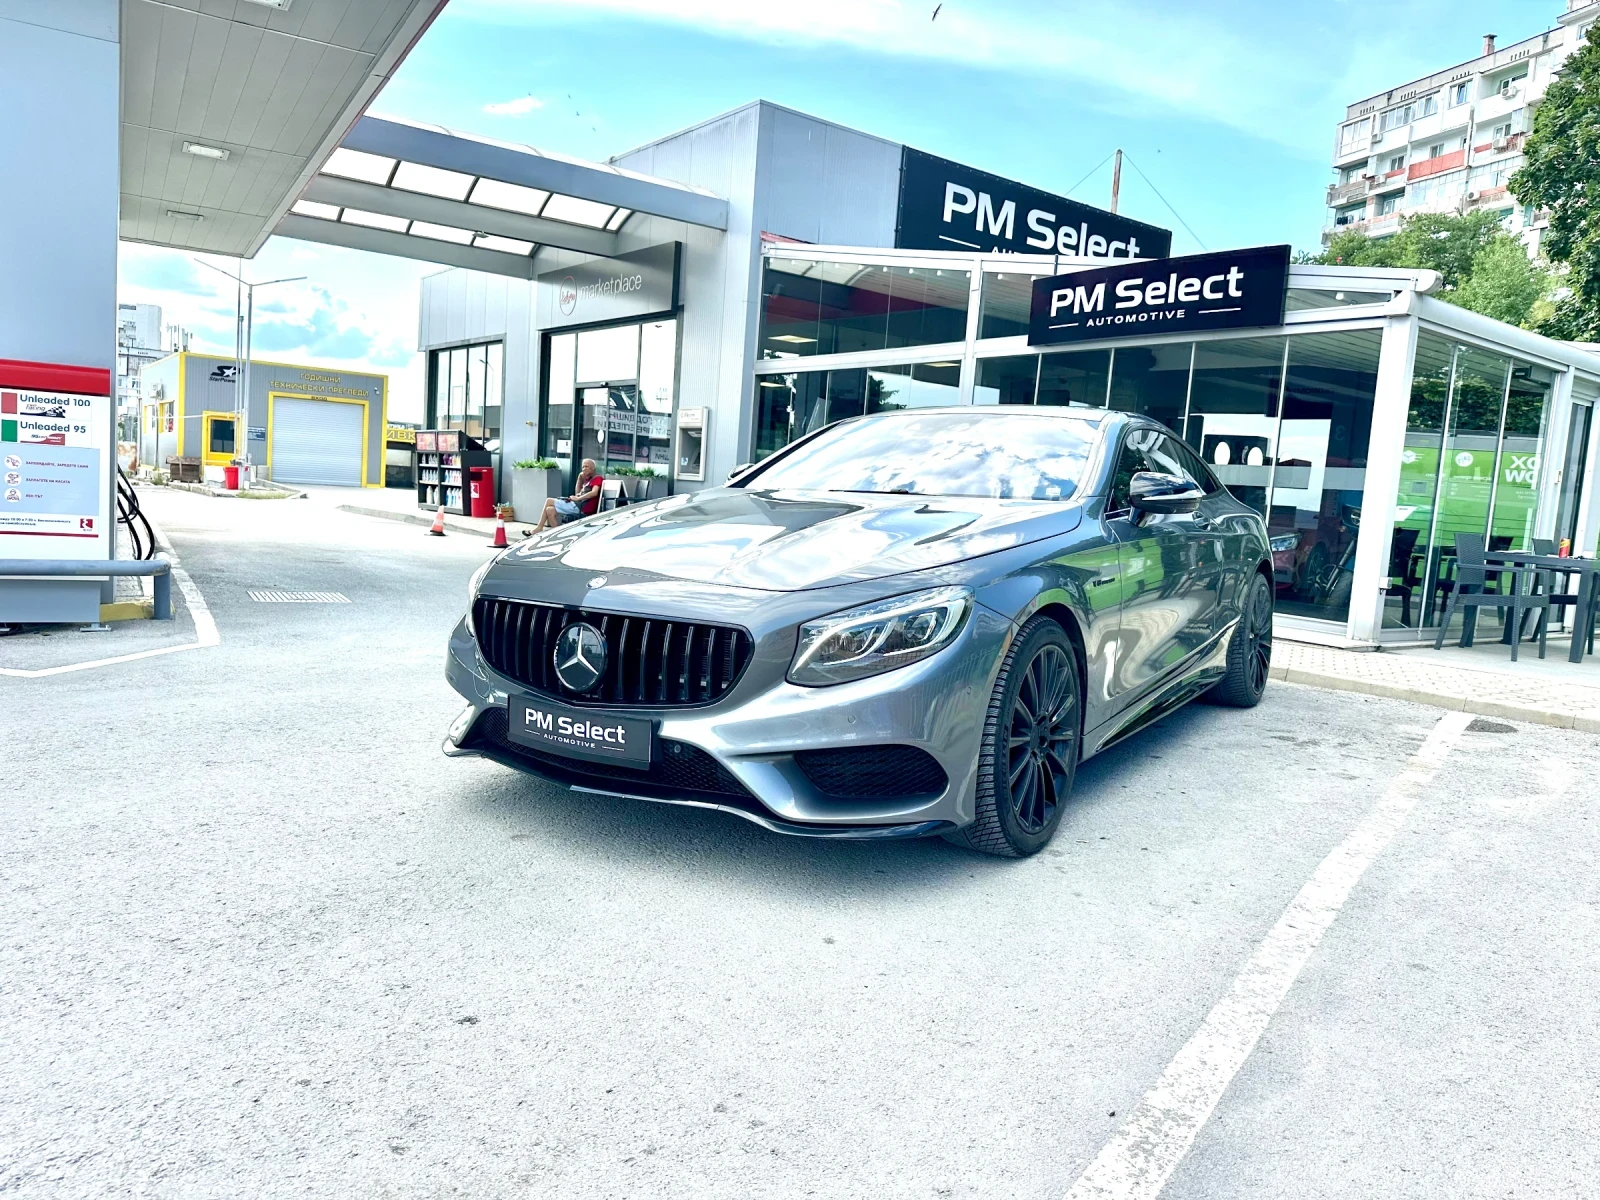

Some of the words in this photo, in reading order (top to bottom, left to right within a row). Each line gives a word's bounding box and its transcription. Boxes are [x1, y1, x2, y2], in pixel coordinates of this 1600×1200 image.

[943, 182, 1016, 239] PM
[1026, 208, 1141, 257] Select
[580, 274, 642, 299] marketplace
[1050, 284, 1107, 317] PM
[1115, 266, 1245, 308] Select
[1086, 308, 1187, 328] AUTOMOTIVE
[300, 373, 341, 383] ГОДИШНИ
[269, 380, 326, 393] ТЕХНИЧЕСКИ
[328, 387, 369, 397] ПРЕГЛЕДИ
[20, 394, 70, 406] Unleaded
[73, 398, 91, 406] 100
[20, 421, 70, 433] Unleaded
[74, 425, 86, 433] 95
[525, 708, 553, 730] PM
[558, 717, 625, 743] Select
[543, 733, 596, 749] AUTOMOTIVE
